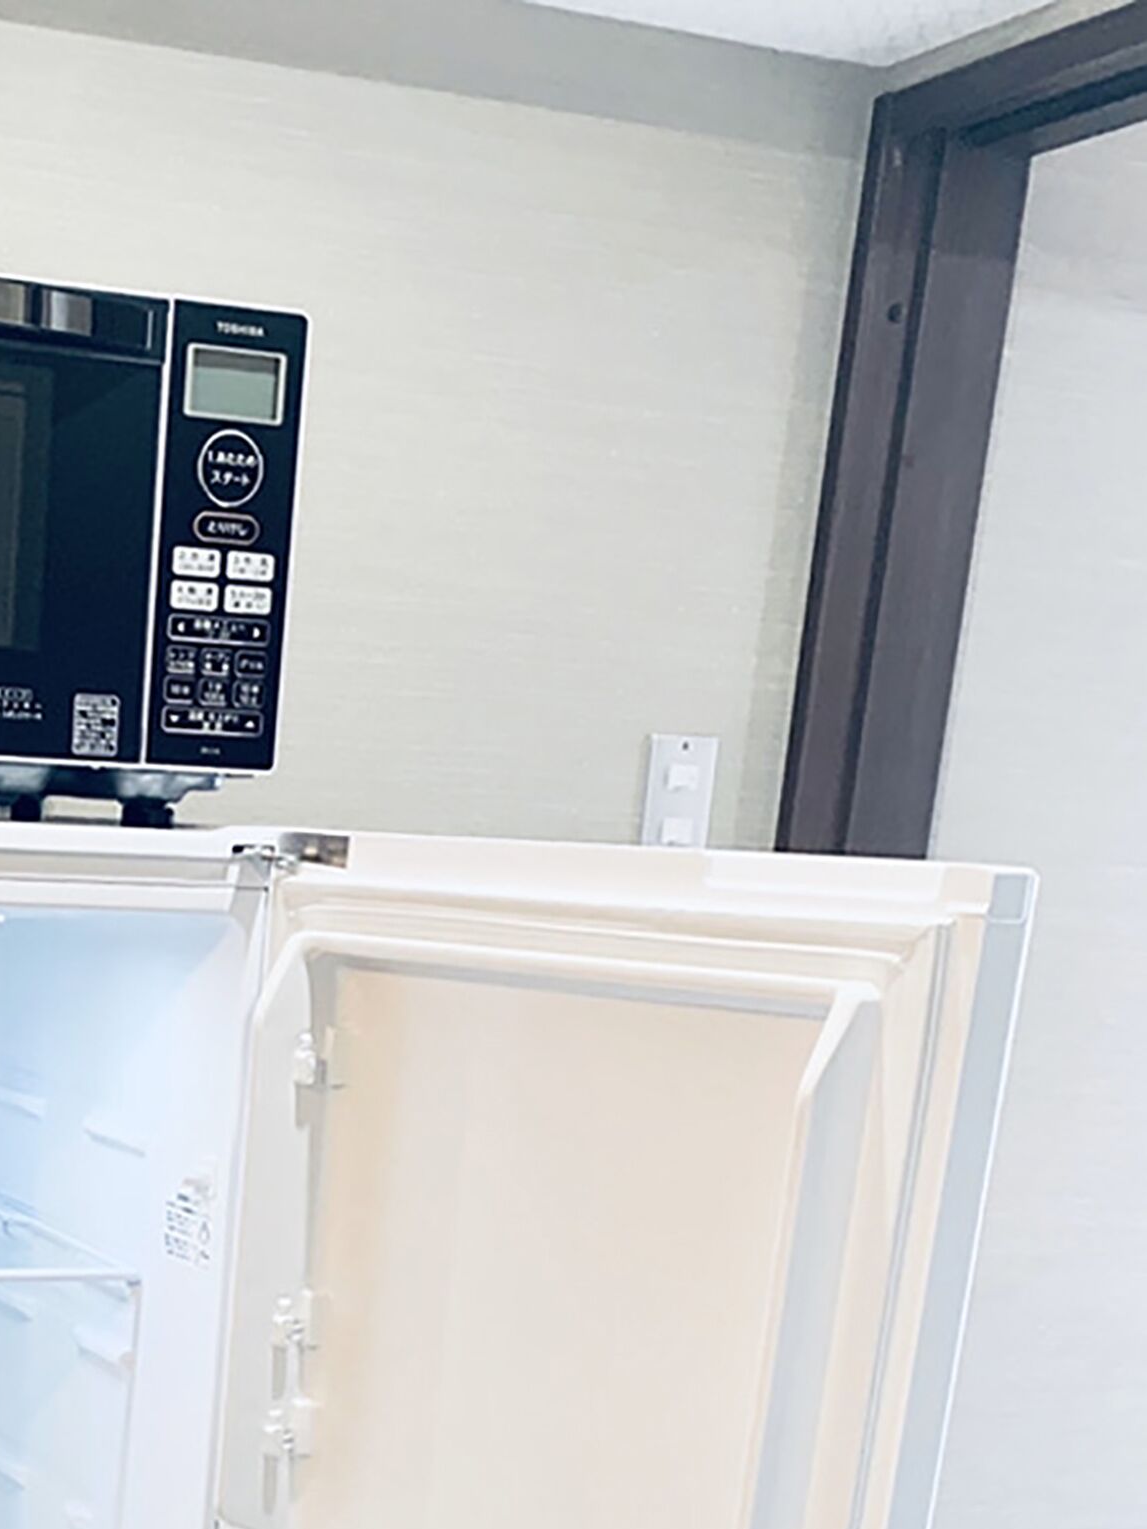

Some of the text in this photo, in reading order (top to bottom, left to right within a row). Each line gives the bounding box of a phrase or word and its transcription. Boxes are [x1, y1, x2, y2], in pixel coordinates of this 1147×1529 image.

[215, 320, 265, 338] TOSHIBA
[210, 469, 251, 487] スタート
[207, 520, 250, 537] とりけし
